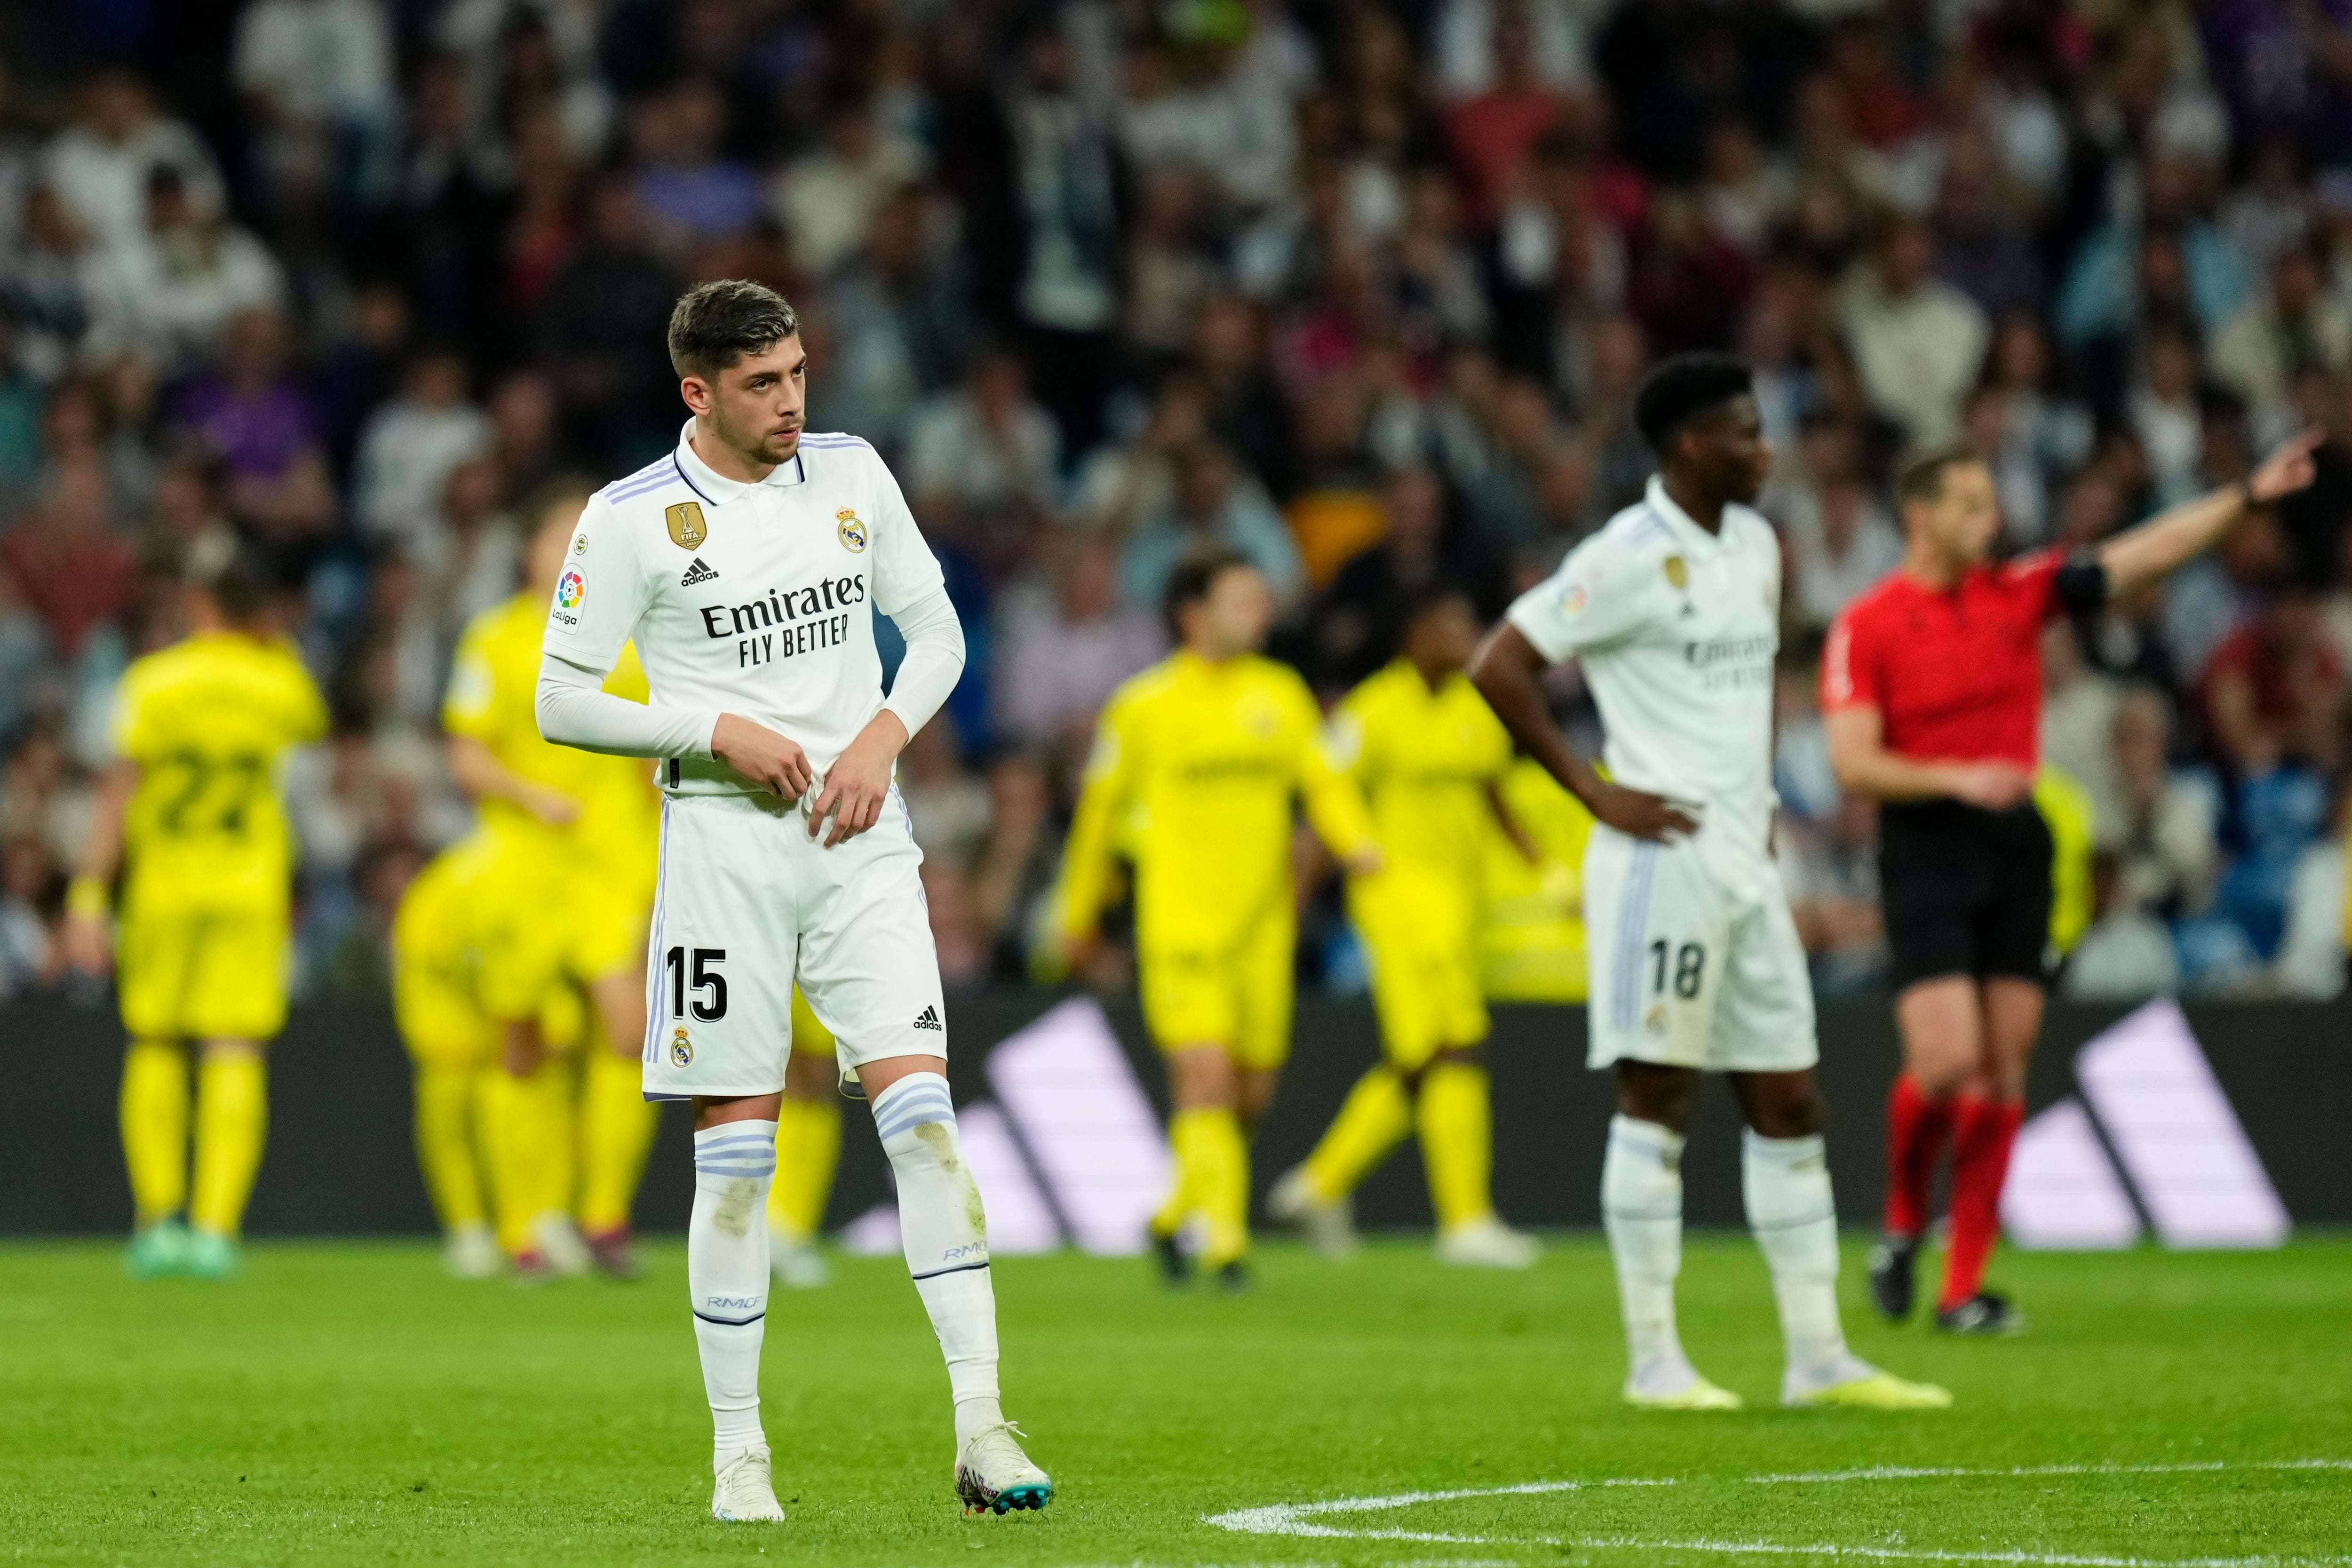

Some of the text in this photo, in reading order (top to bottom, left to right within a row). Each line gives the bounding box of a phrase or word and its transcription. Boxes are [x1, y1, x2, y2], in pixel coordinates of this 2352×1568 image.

[681, 571, 719, 587] adidas
[699, 574, 864, 638] Emirates
[552, 609, 577, 625] LaLiga
[739, 614, 848, 668] FLY BETTER
[1651, 939, 1705, 1000] 18
[667, 946, 727, 1023] 15
[914, 1019, 942, 1031] adidas
[944, 1240, 988, 1261] RMC
[707, 1296, 763, 1308] RMCF
